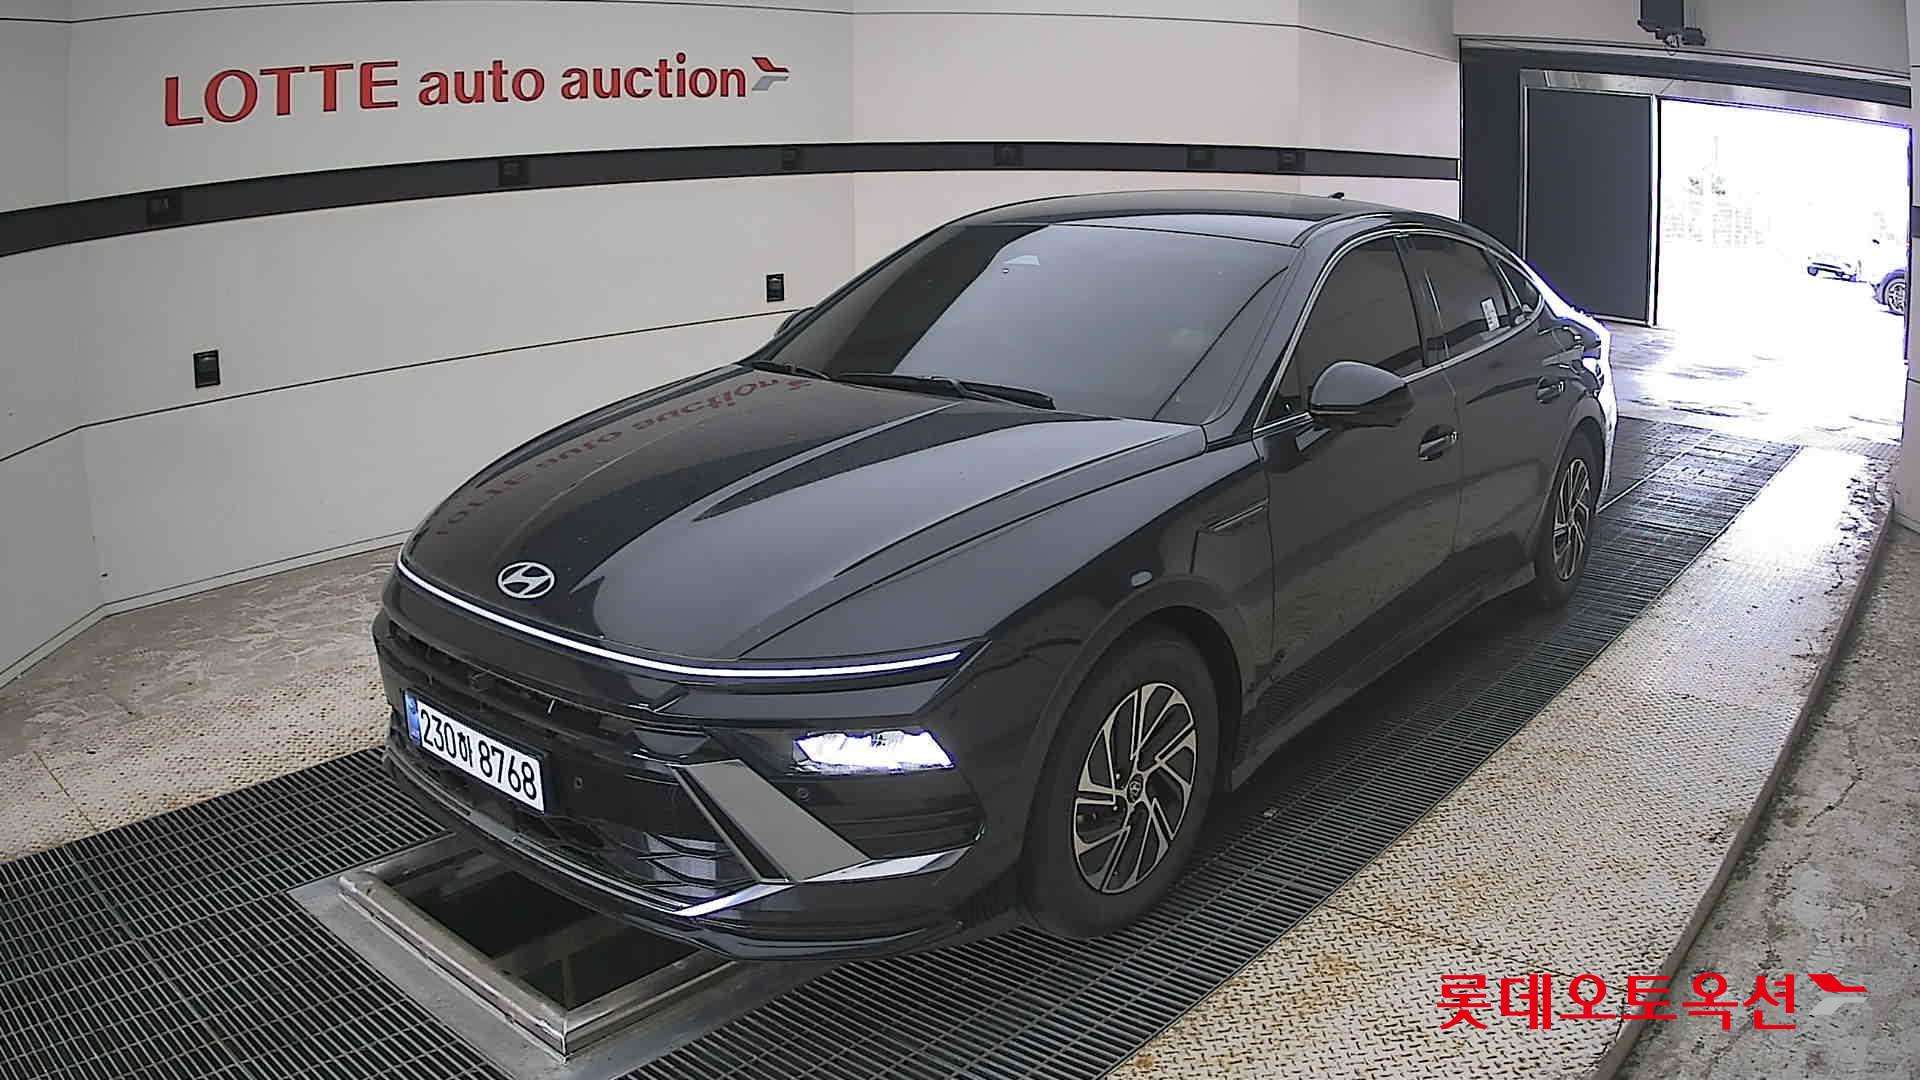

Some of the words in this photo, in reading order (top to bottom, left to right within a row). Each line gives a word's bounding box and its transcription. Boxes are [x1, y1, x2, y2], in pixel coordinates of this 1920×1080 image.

[163, 60, 400, 127] LOTTE
[416, 59, 546, 106] auto
[559, 52, 748, 101] auction
[478, 740, 537, 800] 8768
